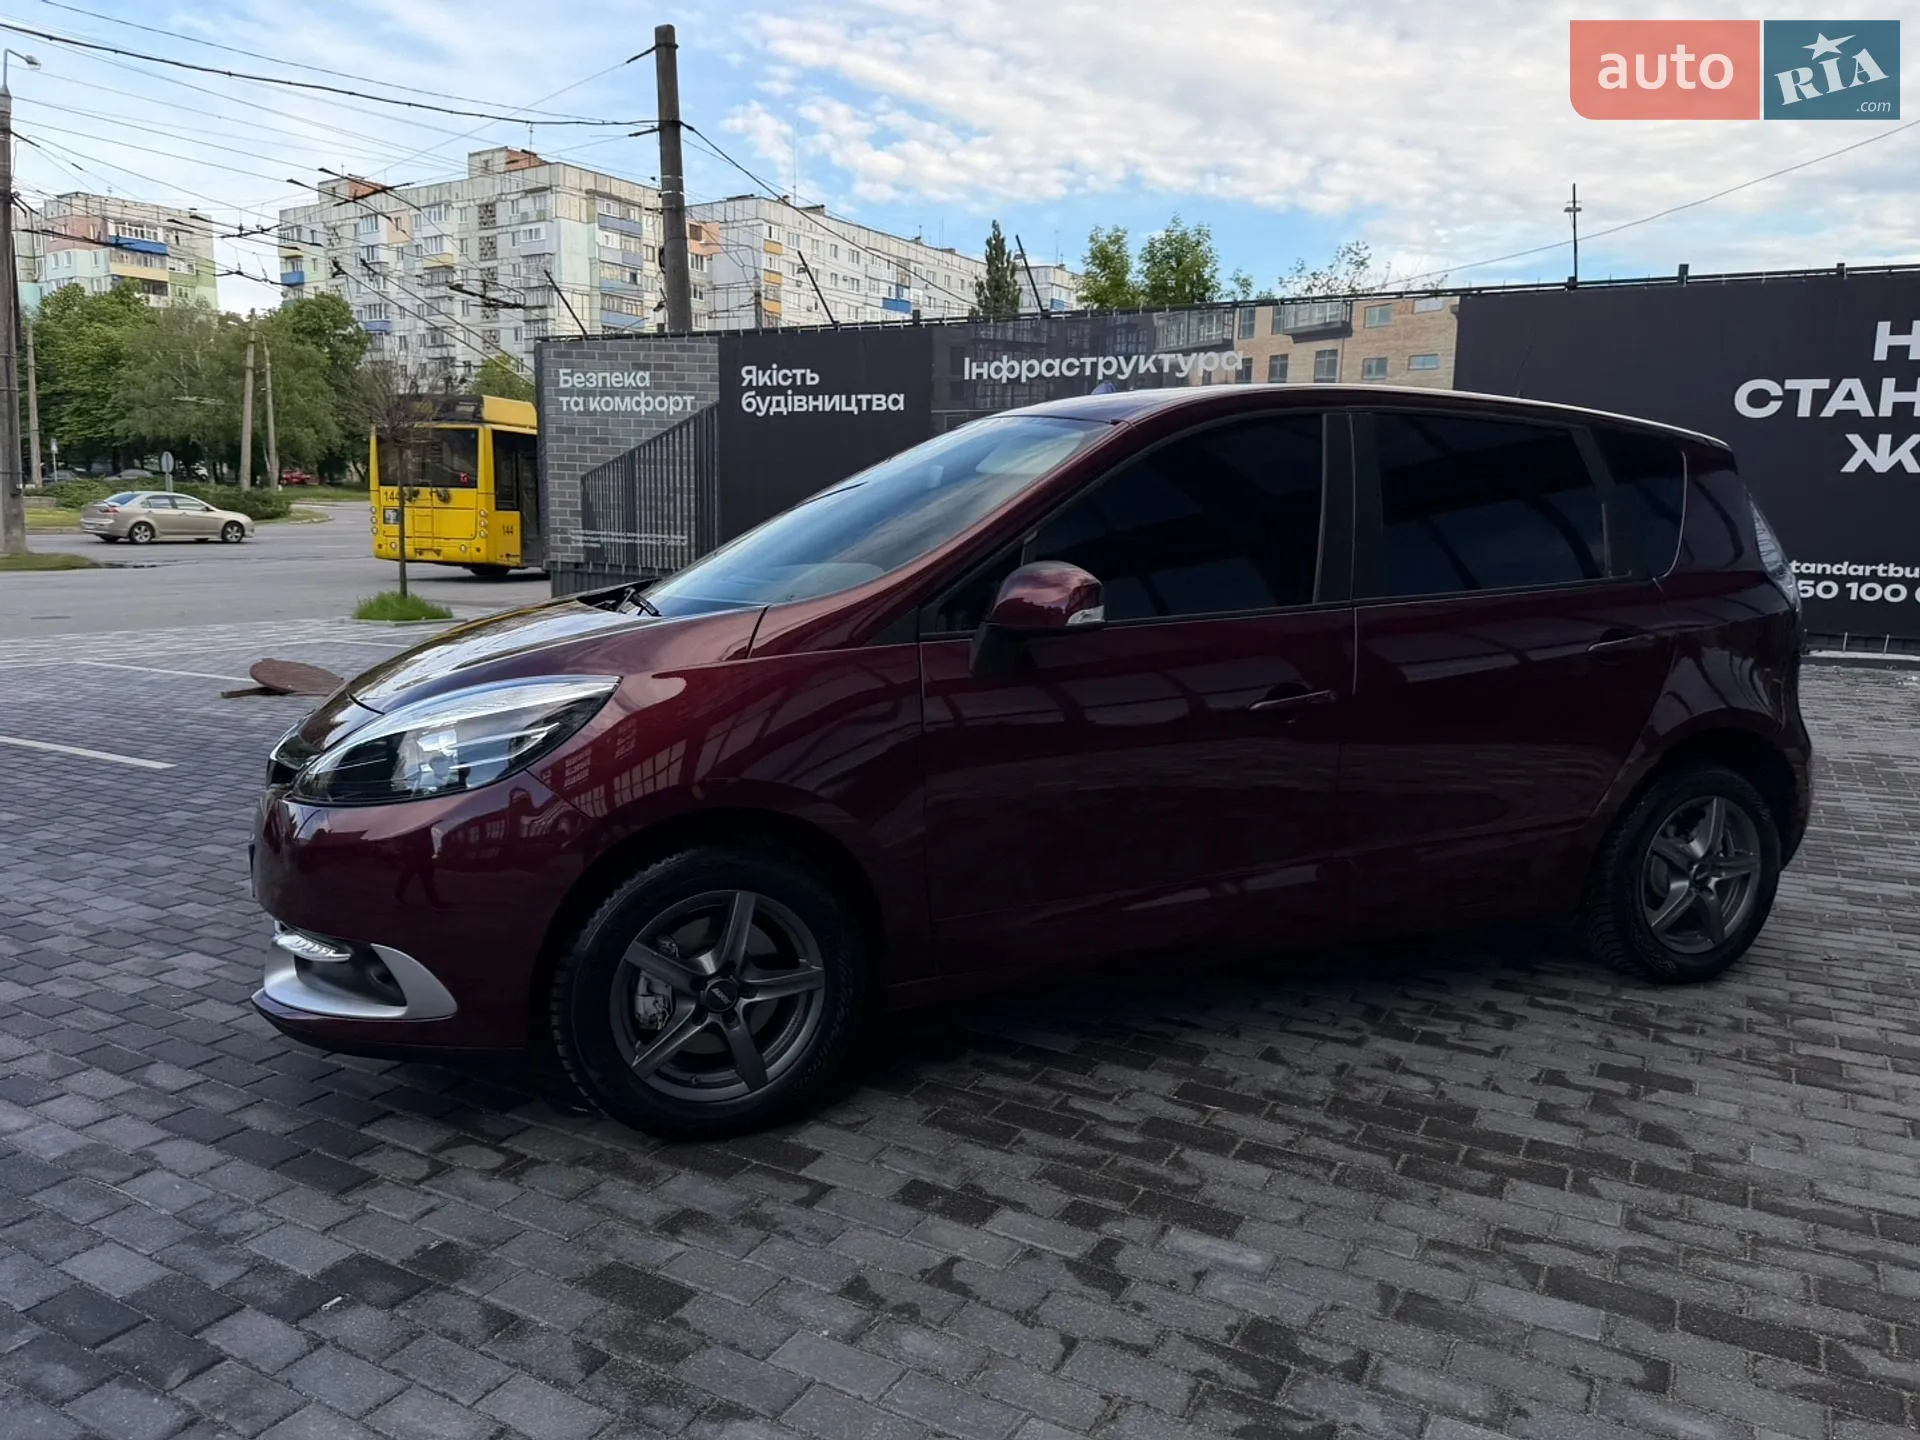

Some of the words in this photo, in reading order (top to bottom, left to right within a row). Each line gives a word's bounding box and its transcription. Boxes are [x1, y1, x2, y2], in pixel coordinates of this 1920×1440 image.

[1873, 320, 1920, 361] Н
[558, 368, 650, 389] Безпека
[740, 363, 820, 388] Якість
[963, 350, 1243, 385] Інфраструктура
[559, 395, 586, 413] та
[589, 391, 695, 416] комфорт
[741, 390, 905, 416] будівництва
[1734, 377, 1920, 418] СТАН
[1840, 433, 1920, 474] Ж
[1797, 579, 1839, 599] 50
[1845, 581, 1908, 603] 100
